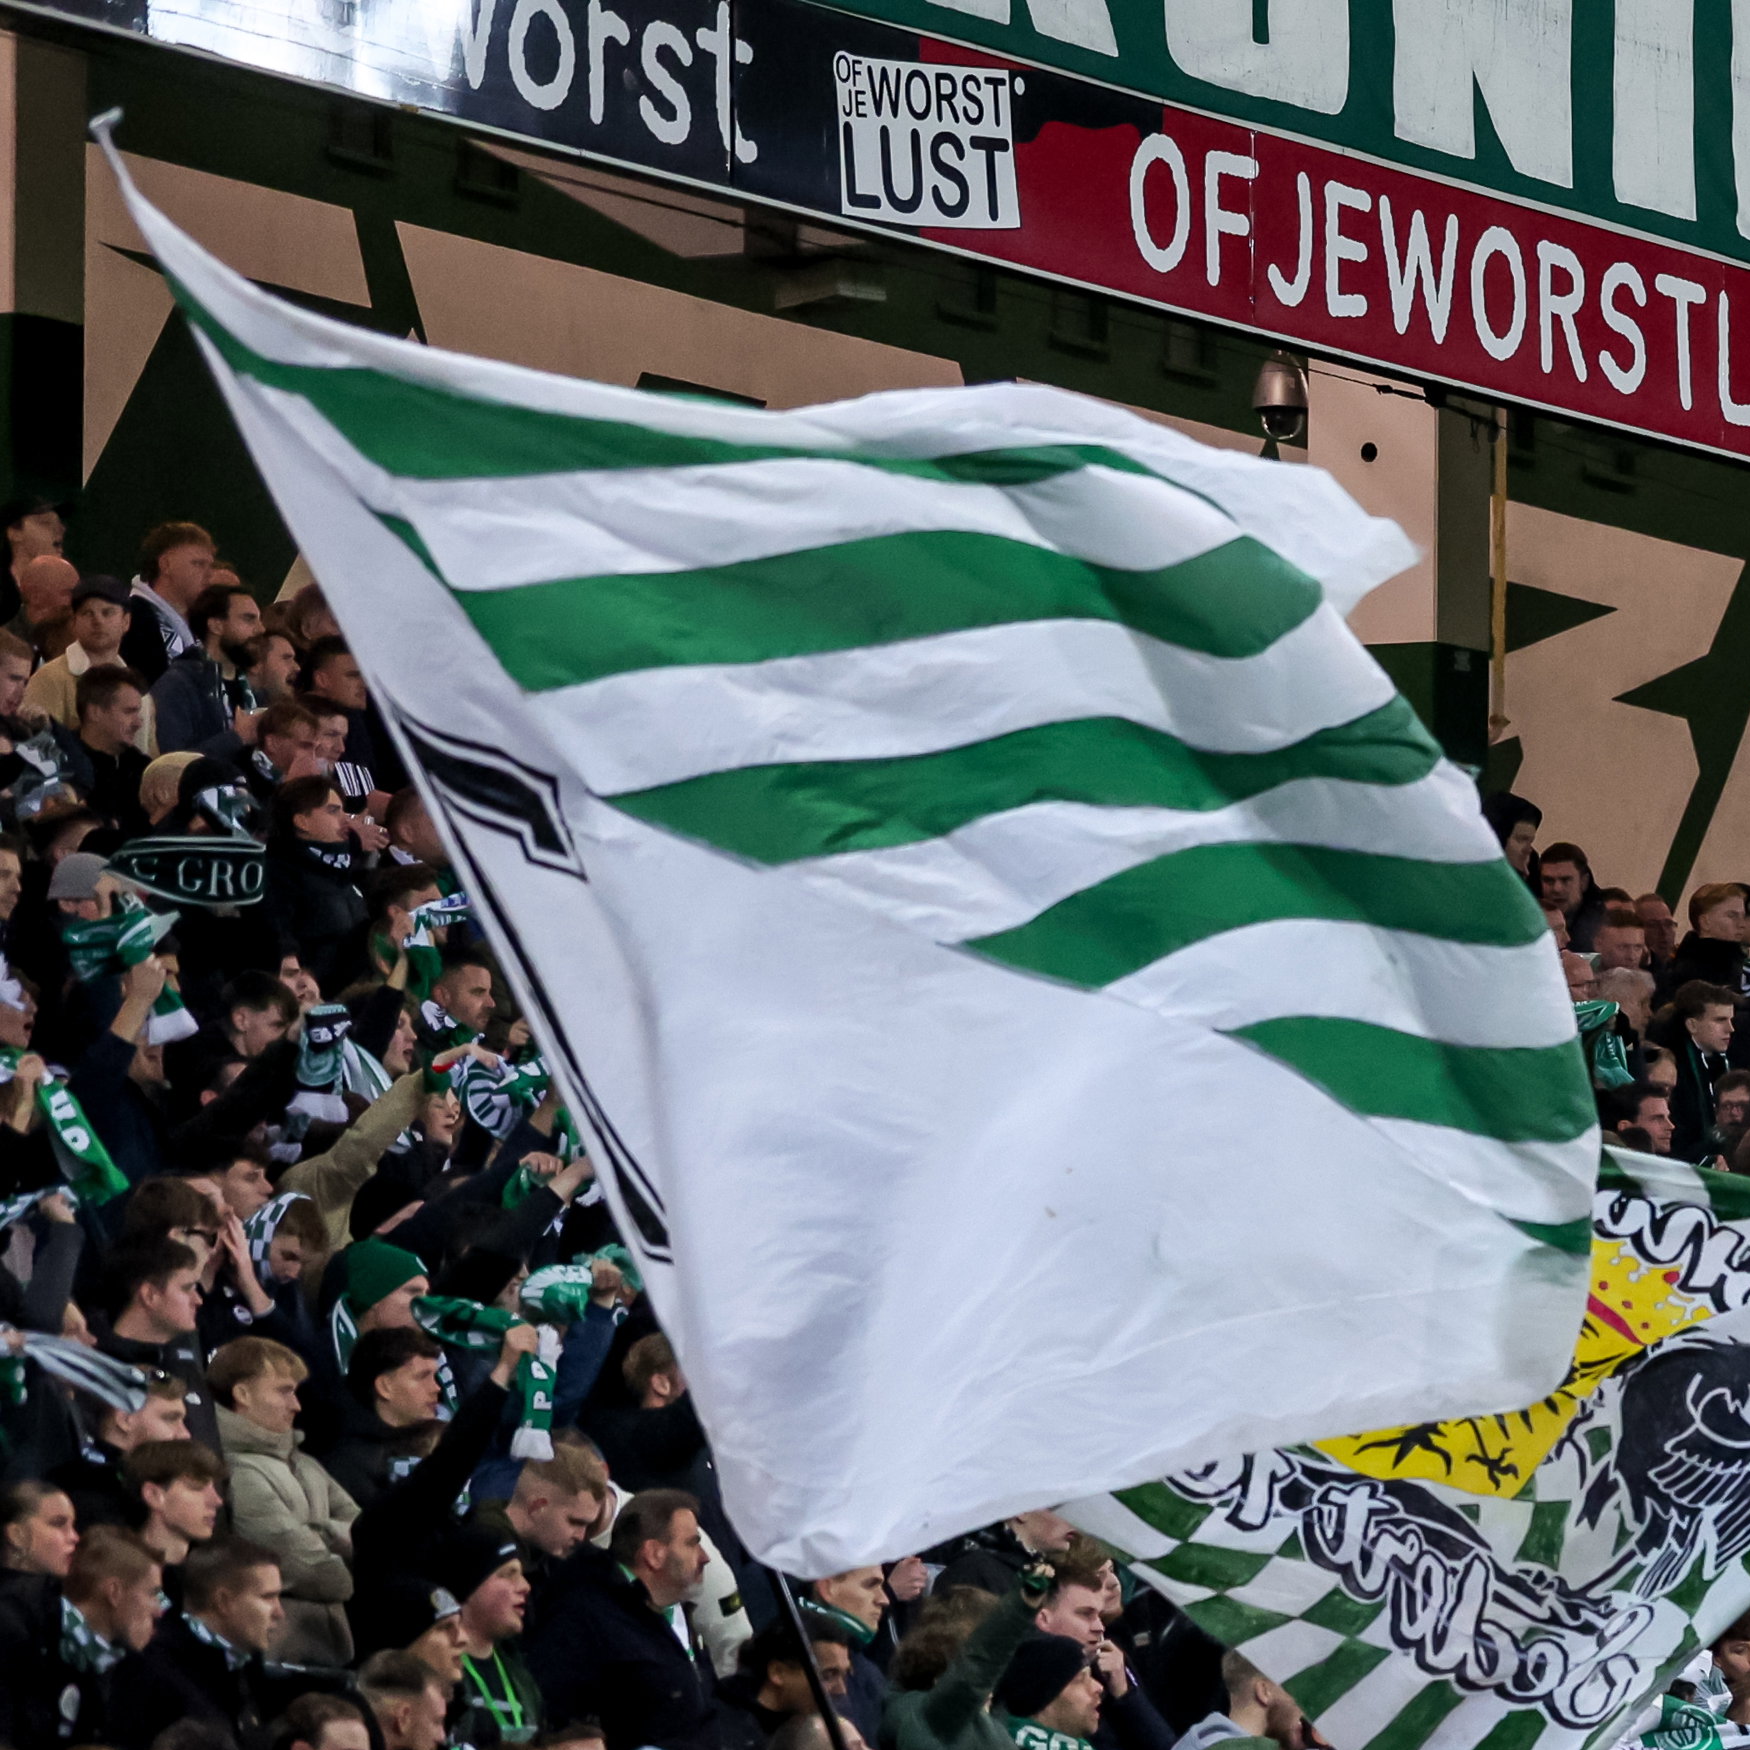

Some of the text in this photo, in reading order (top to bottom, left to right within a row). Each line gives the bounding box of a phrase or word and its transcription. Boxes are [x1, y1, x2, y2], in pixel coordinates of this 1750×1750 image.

[834, 54, 863, 84] OF
[867, 65, 1007, 127] WORST
[842, 89, 867, 118] JE
[843, 121, 1010, 222] LUST
[1128, 132, 1260, 288] OF
